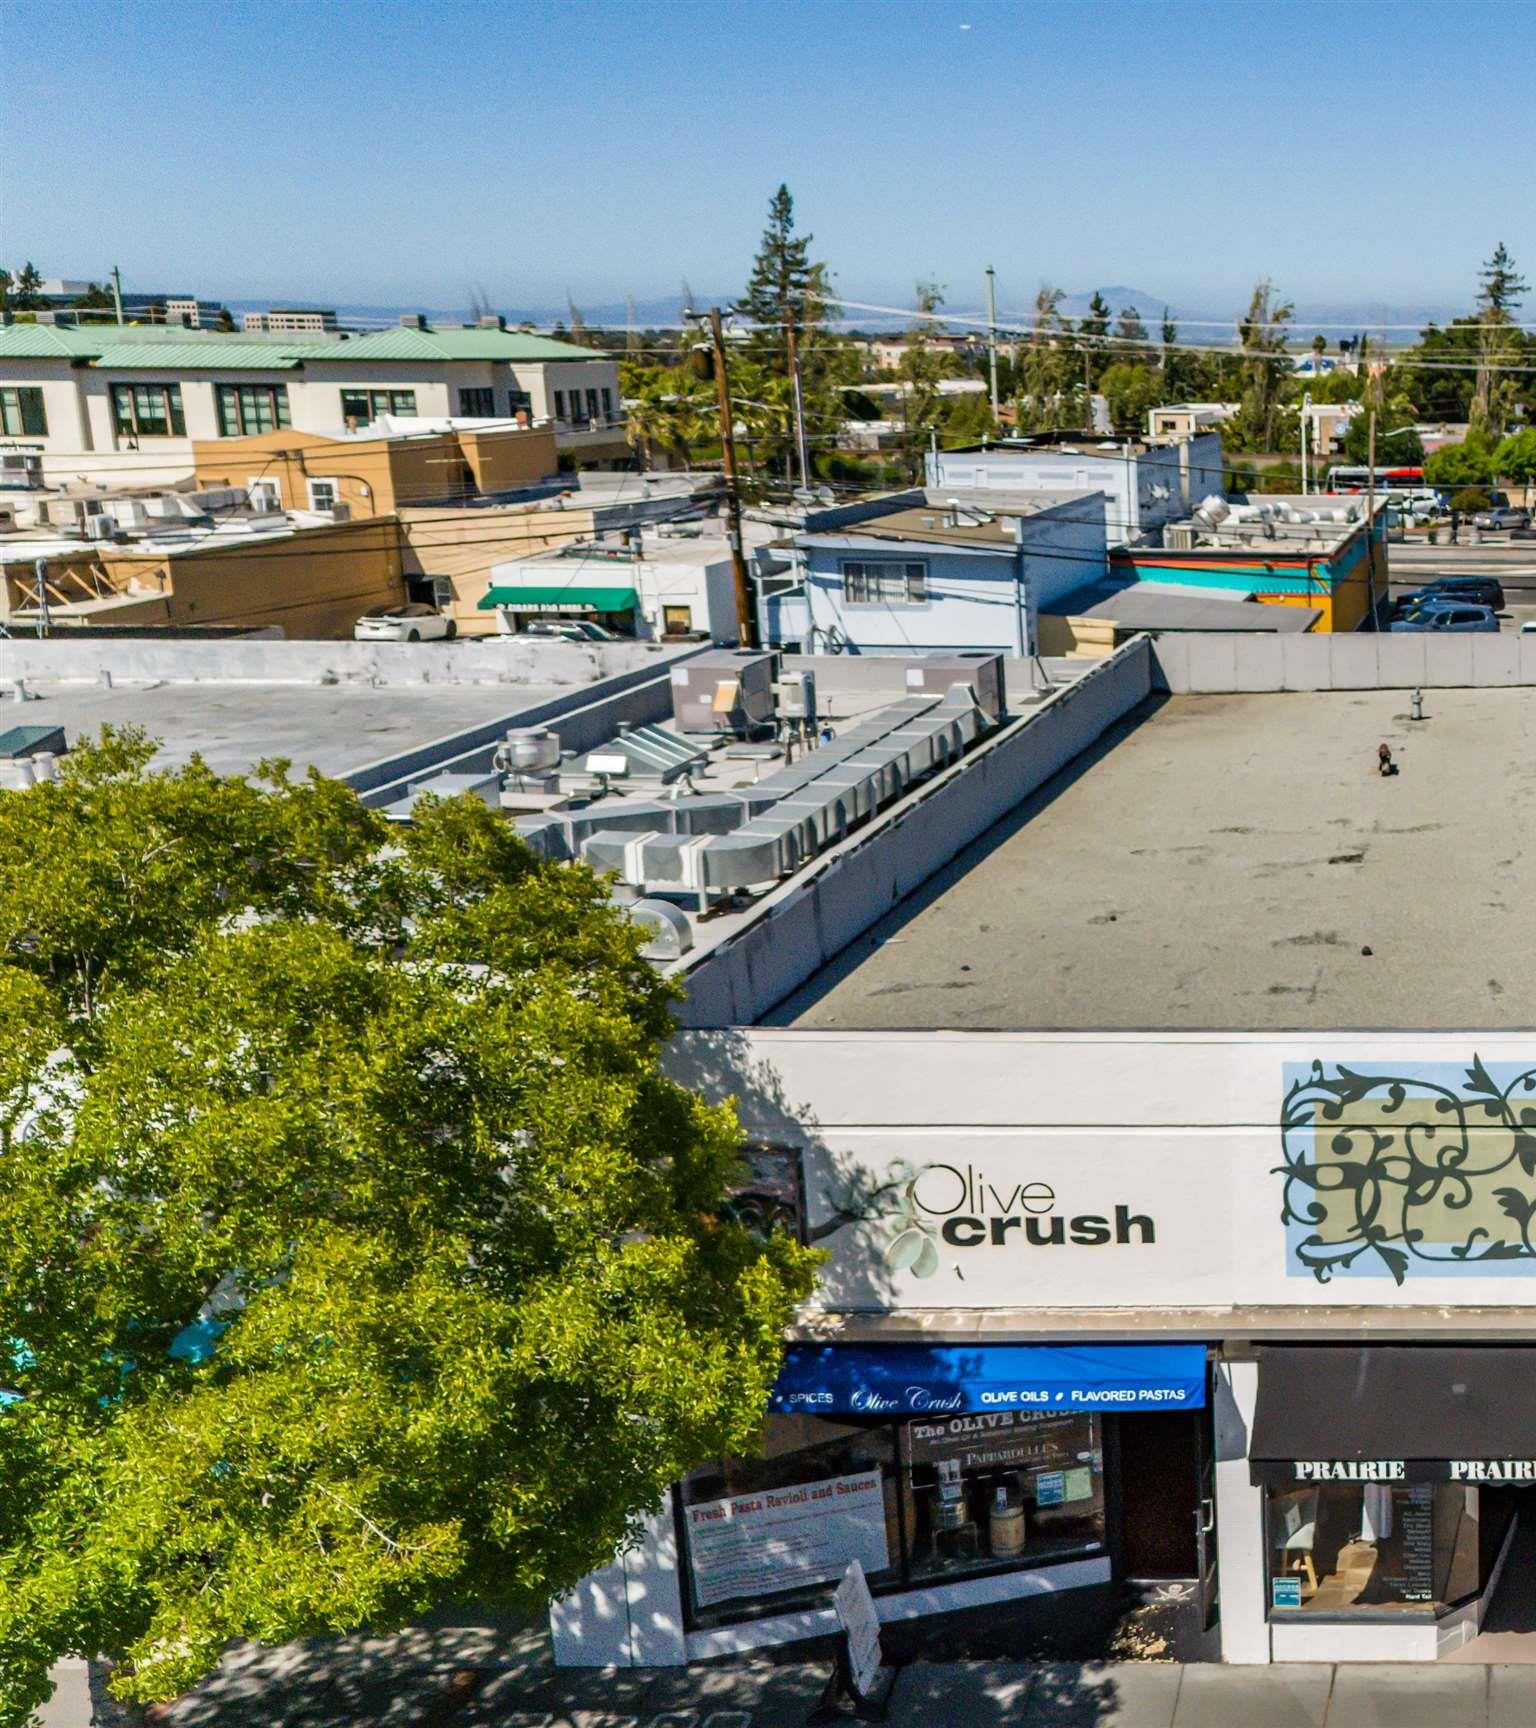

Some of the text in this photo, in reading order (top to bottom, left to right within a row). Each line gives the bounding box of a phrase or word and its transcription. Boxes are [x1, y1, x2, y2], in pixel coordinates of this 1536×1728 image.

[913, 1163, 1056, 1215] Olive
[941, 1204, 1156, 1247] crush
[789, 1386, 1186, 1409] SPICES Olive Crush OLIVE OILS FLAVORED PASTAS
[949, 1411, 1013, 1434] OLIVE
[1293, 1460, 1406, 1480] PRAIRIE
[692, 1478, 877, 1523] Fresh Pasta Ravioli and Sauces
